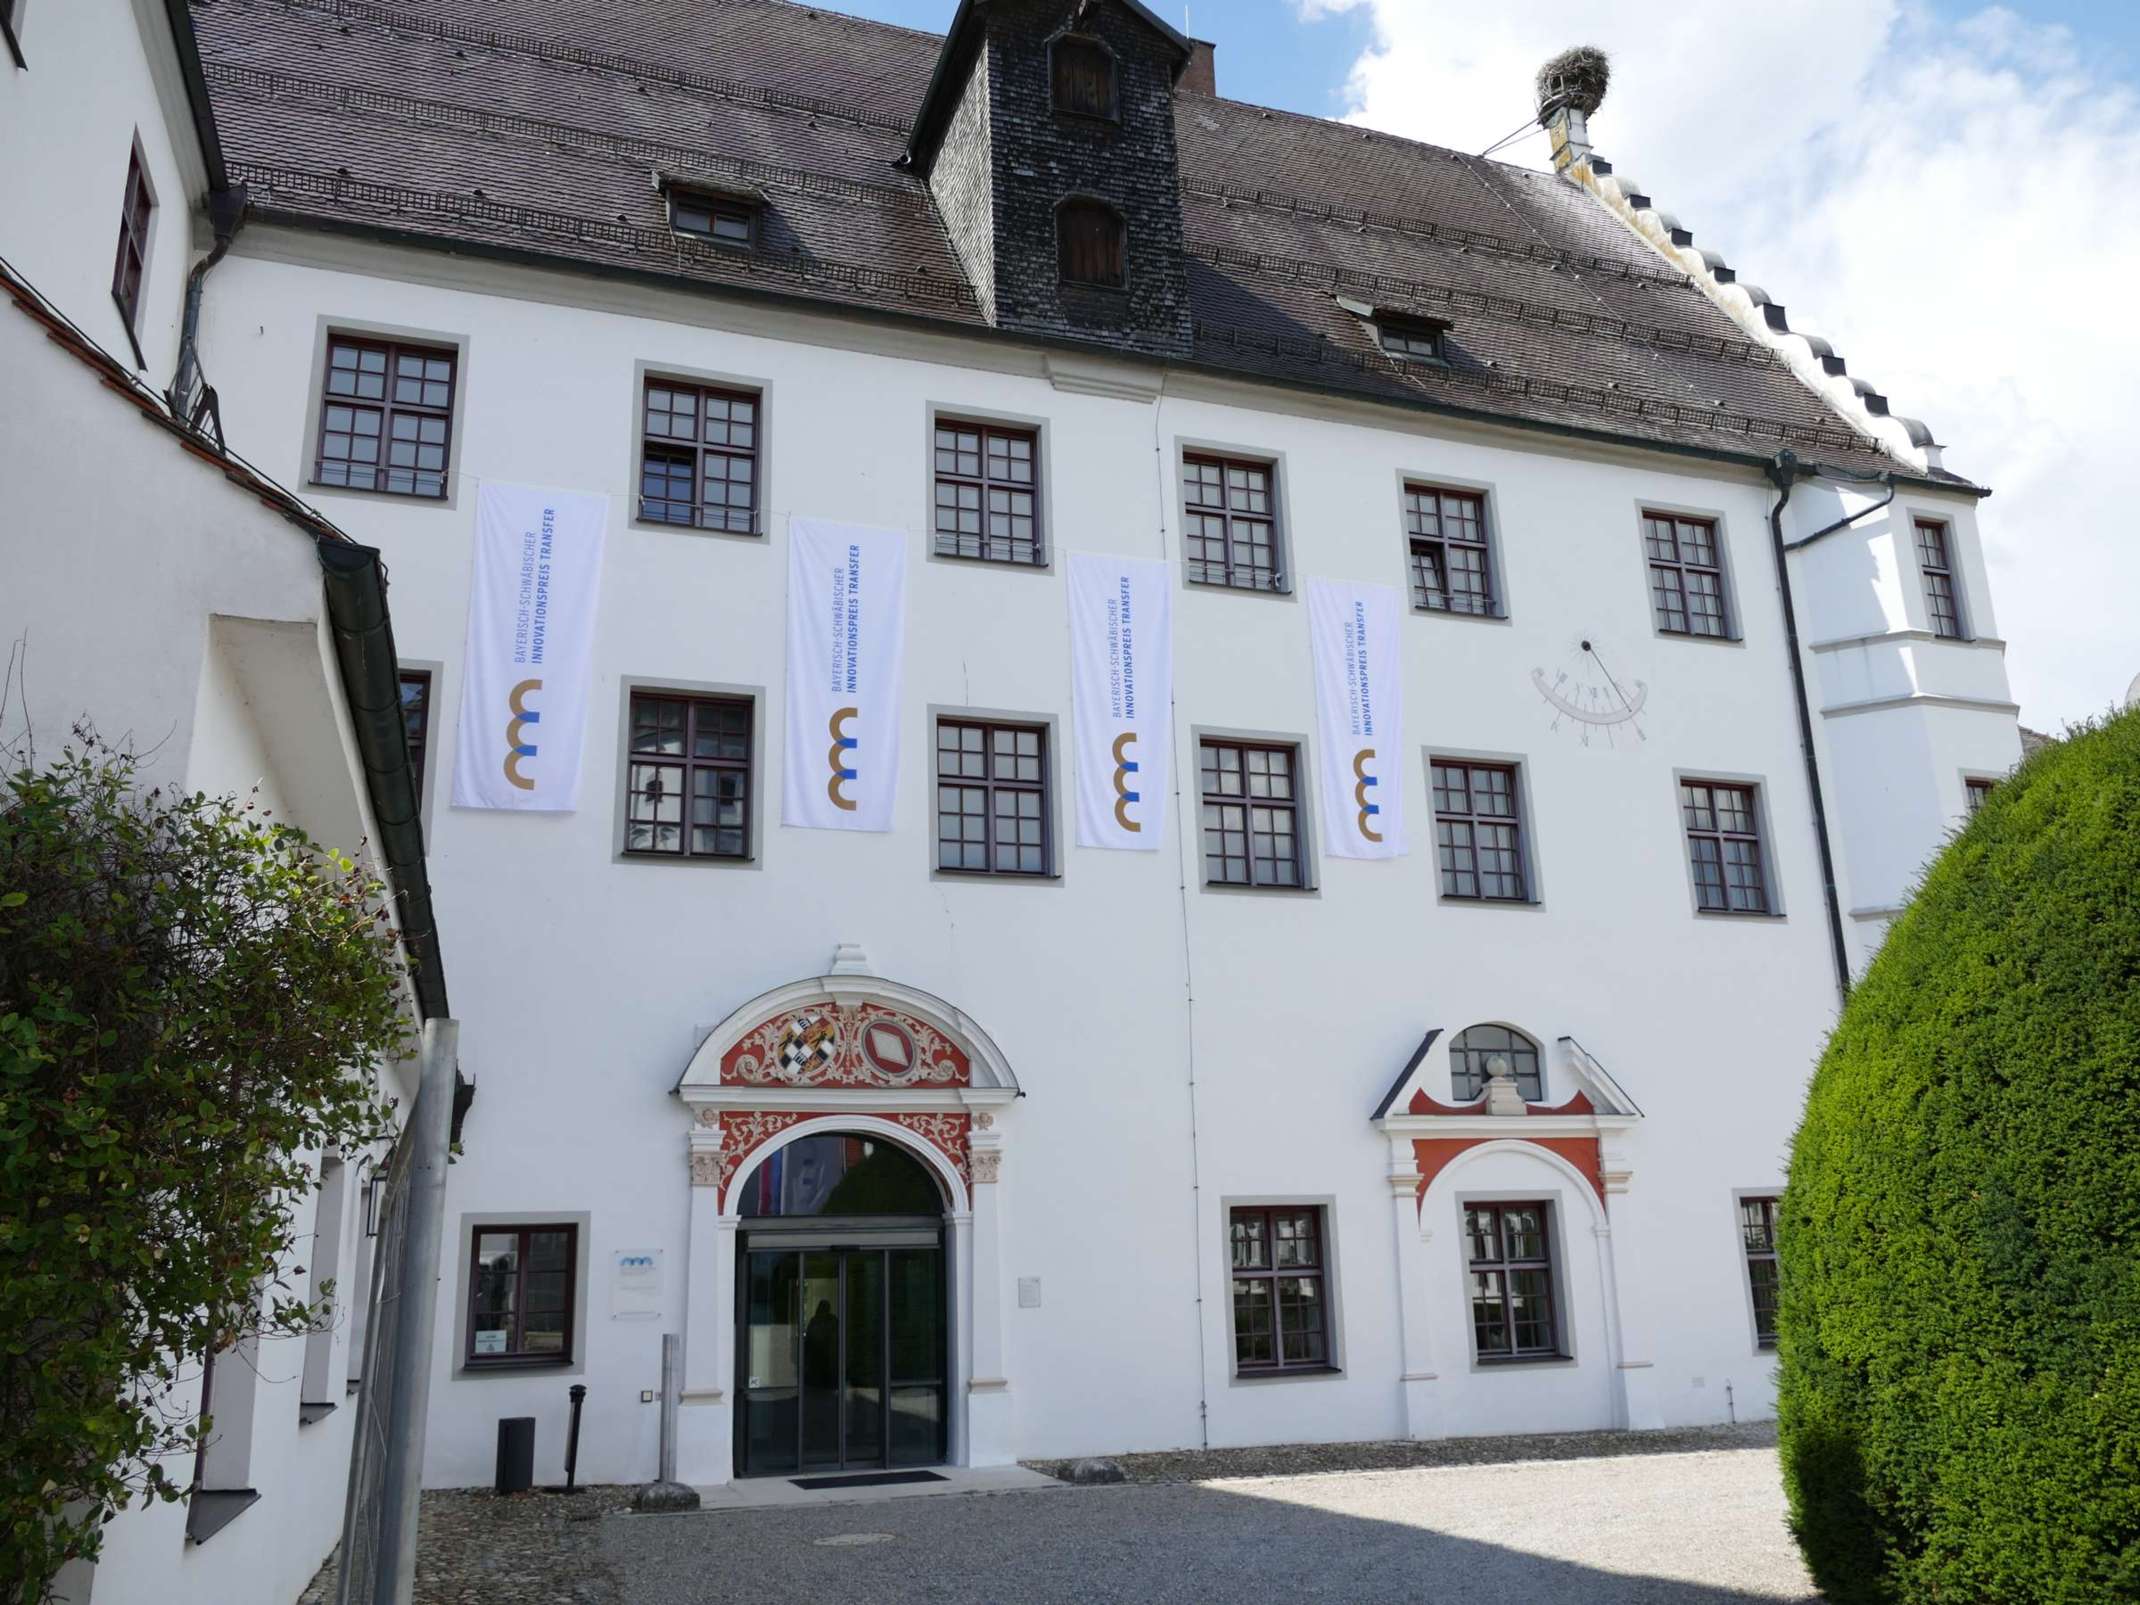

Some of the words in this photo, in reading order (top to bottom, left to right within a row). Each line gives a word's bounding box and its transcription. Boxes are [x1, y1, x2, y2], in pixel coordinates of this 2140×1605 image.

[540, 508, 555, 560] TRANSFER
[848, 544, 860, 594] TRANSFER
[514, 530, 537, 664] BAYERISCH-SCHWÄBISCHER
[531, 564, 550, 664] INNOVATIONSPREIS
[832, 567, 845, 693] BAYERISCH-SCHWÄBISCHER
[1121, 576, 1131, 625] TRANSFER
[1356, 601, 1365, 645] TRANSFER
[847, 599, 859, 694] INNOVATIONSPREIS
[1108, 597, 1122, 718] BAYERISCH-SCHWÄBISCHER
[1122, 628, 1135, 719] INNOVATIONSPREIS
[1359, 649, 1373, 736] INNOVATIONSPREIS
